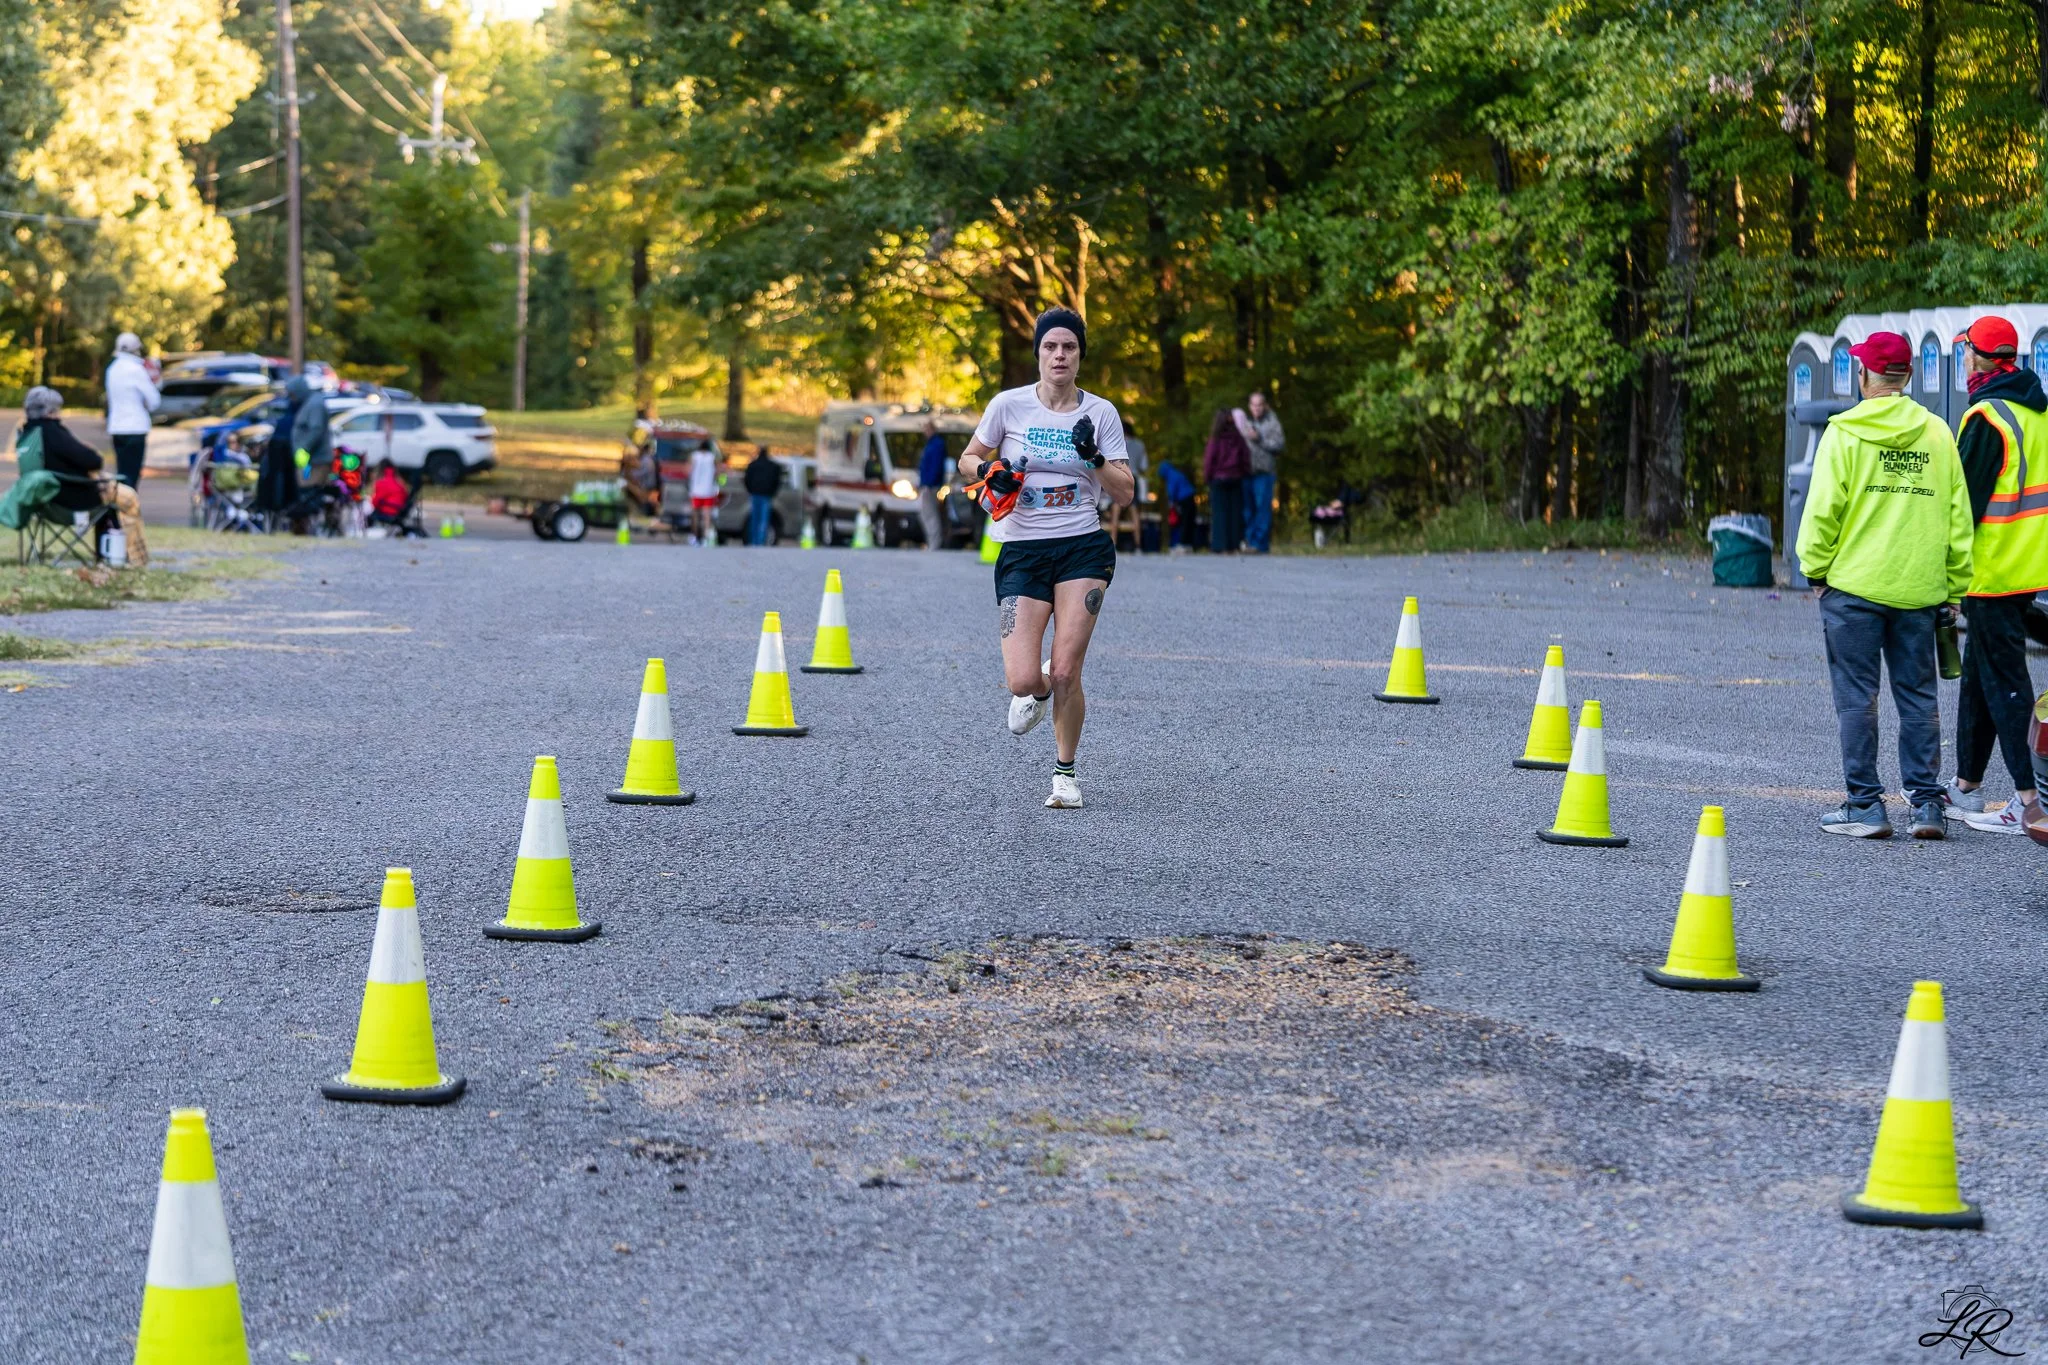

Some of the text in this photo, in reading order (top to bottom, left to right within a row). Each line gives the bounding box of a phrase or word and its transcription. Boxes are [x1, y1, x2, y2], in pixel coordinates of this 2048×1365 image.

[1027, 431, 1073, 444] CHICAG
[1031, 441, 1076, 451] MARATHON
[1879, 450, 1930, 464] MEMPHIS
[1884, 461, 1923, 471] RUNNERS
[1891, 485, 1910, 494] LINE
[1911, 487, 1936, 496] CREW
[1044, 490, 1075, 507] 229
